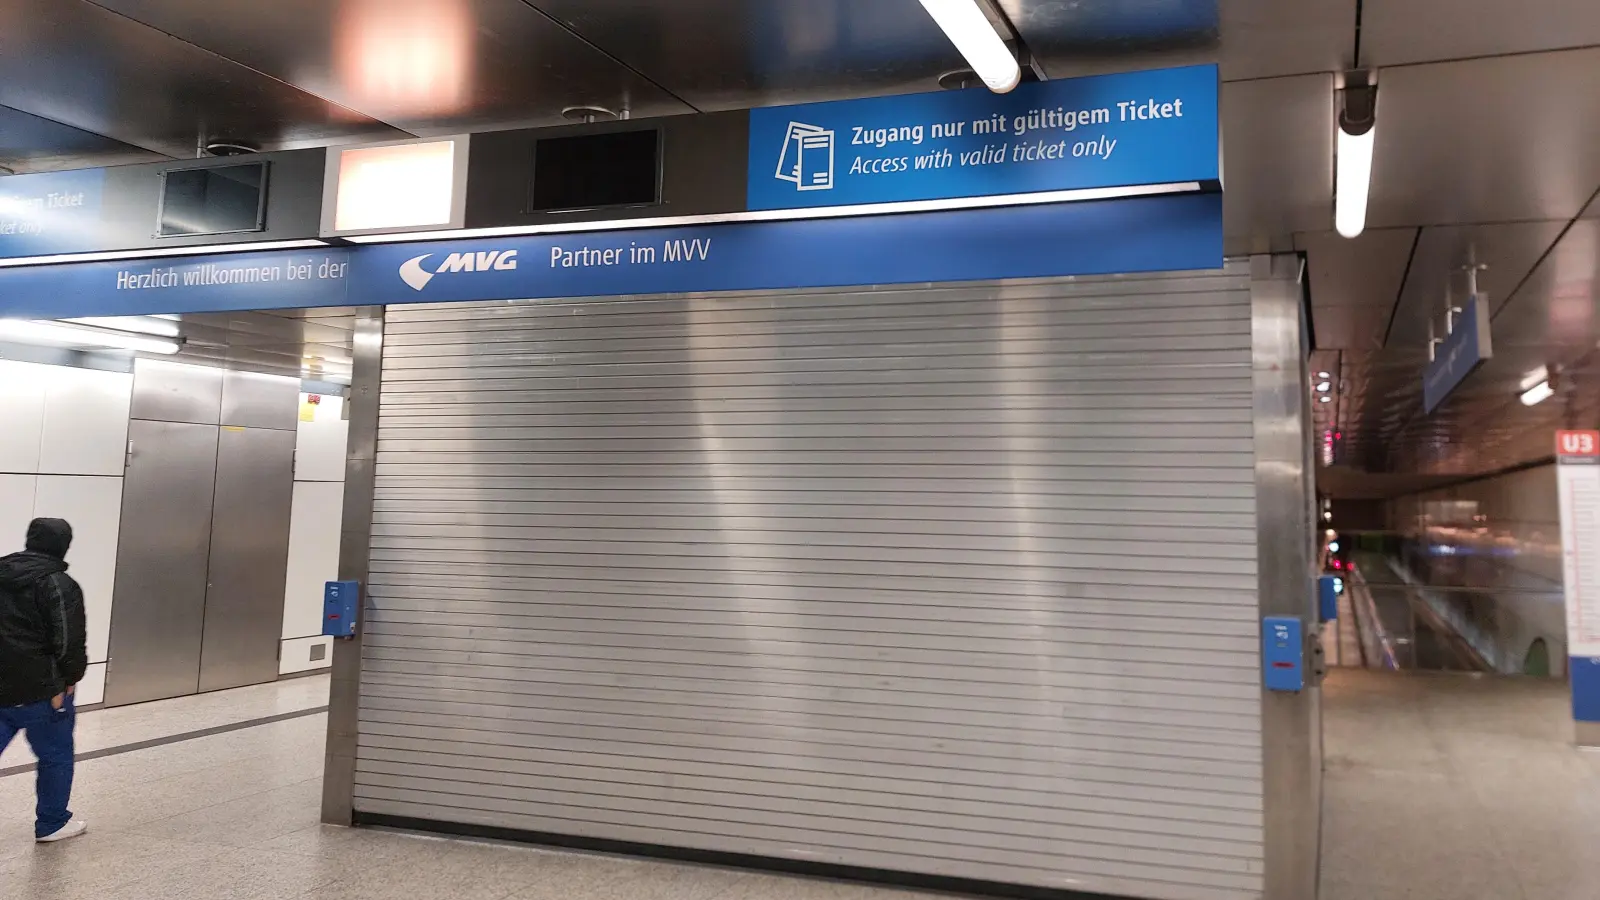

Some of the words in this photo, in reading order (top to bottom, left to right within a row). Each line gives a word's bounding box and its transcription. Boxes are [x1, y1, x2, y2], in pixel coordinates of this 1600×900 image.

[851, 126, 925, 148] Zugang
[931, 123, 965, 139] nur
[972, 112, 1007, 136] mit
[1013, 107, 1110, 136] gültigem
[1116, 97, 1183, 122] Ticket
[848, 155, 908, 176] Access
[913, 146, 954, 170] with
[959, 142, 1006, 167] valid
[1012, 138, 1066, 161] ticket
[1071, 134, 1117, 159] only
[46, 191, 84, 210] Ticket
[435, 250, 518, 274] MVG
[550, 245, 625, 269] Partner
[629, 241, 656, 264] im
[662, 237, 712, 263] MVV
[116, 267, 179, 290] Herzlich
[182, 262, 281, 287] willkommen
[286, 257, 313, 280] bei
[317, 255, 348, 279] der
[1563, 433, 1593, 454] U3
